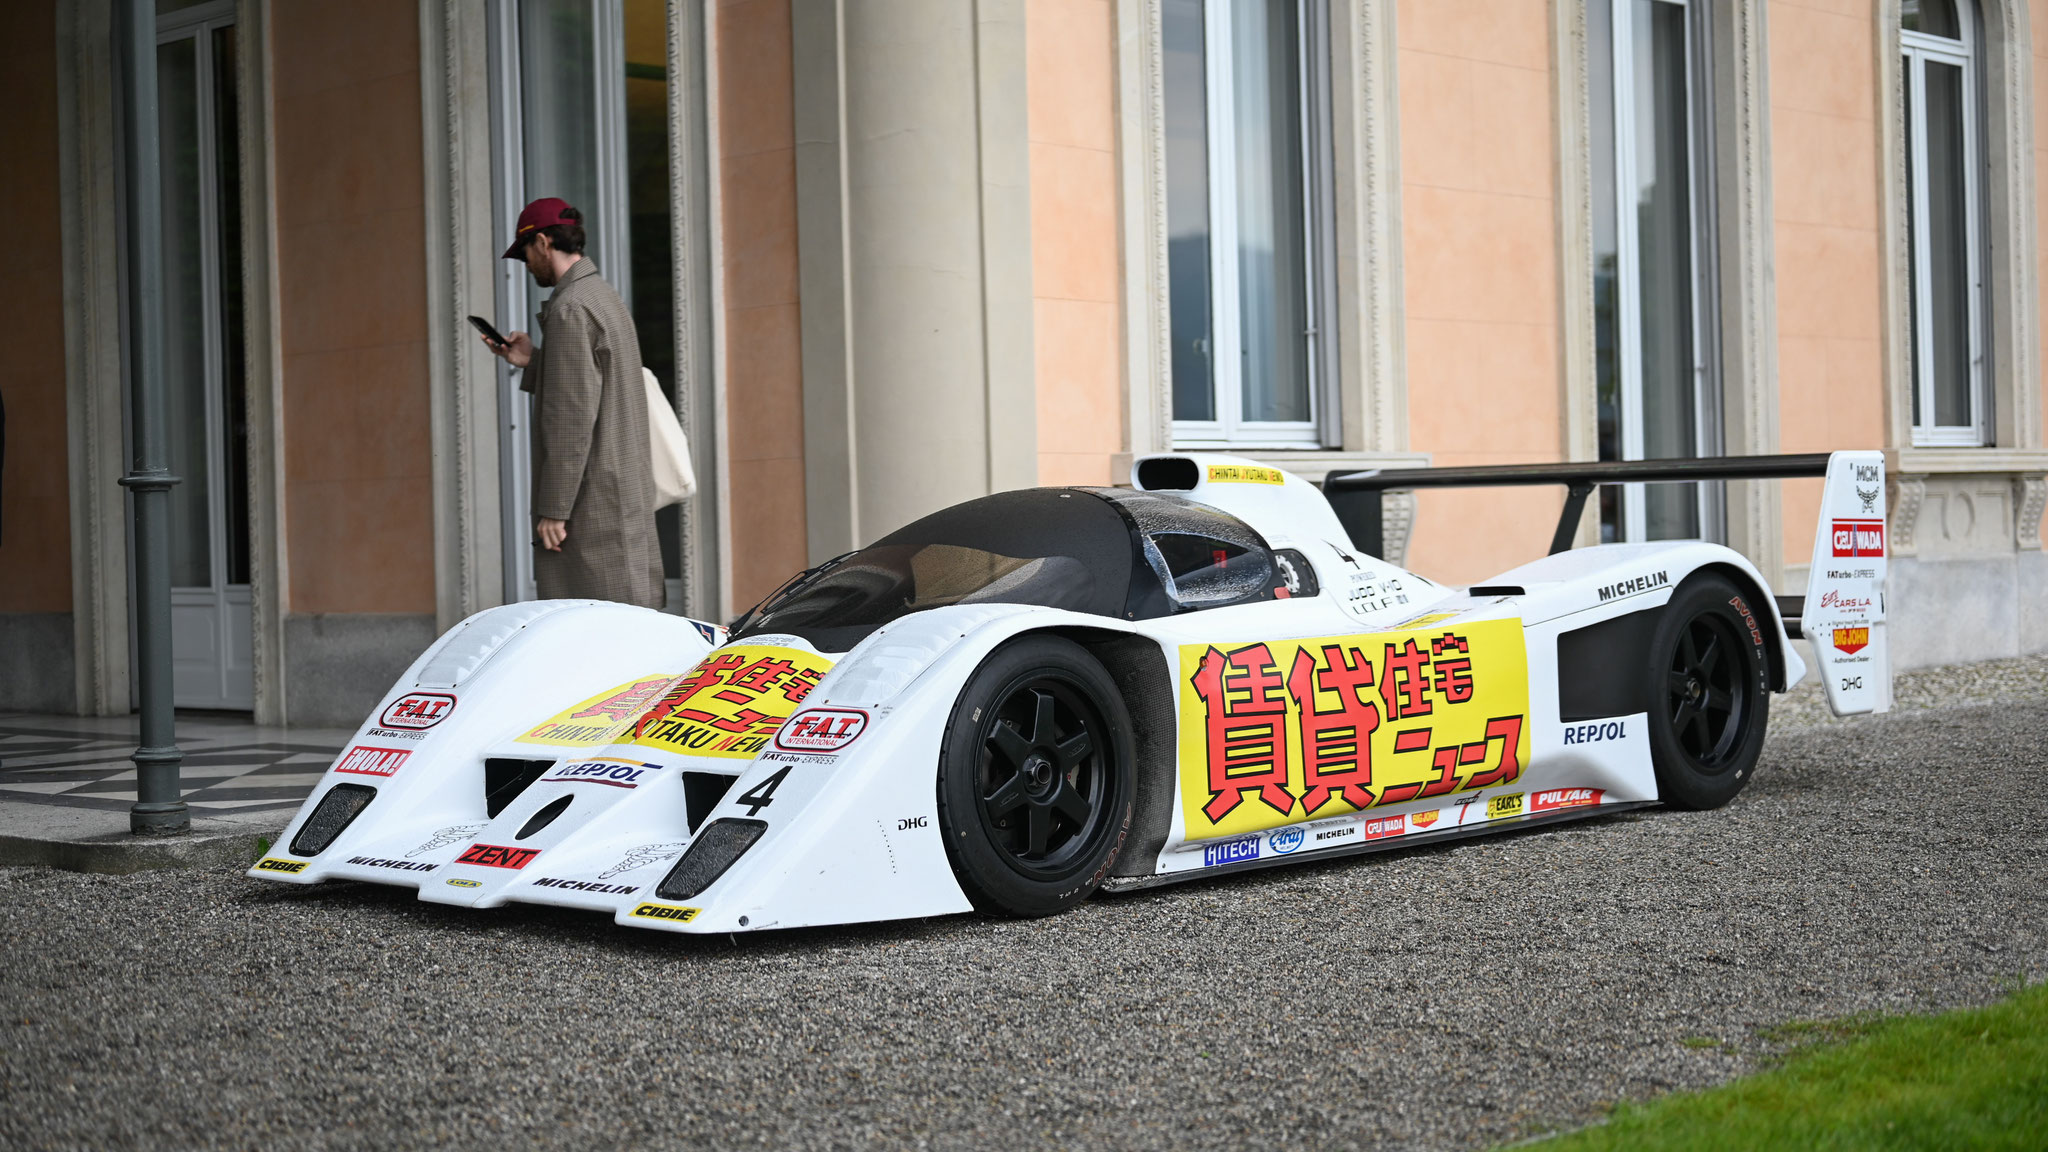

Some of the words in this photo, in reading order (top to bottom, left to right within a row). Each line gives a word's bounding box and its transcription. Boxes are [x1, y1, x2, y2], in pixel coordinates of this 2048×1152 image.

[1210, 468, 1240, 480] CHINTAI
[1856, 465, 1879, 482] MCM
[1856, 530, 1882, 550] WADA
[1597, 570, 1668, 601] MICHELIN
[1834, 599, 1857, 608] CARS
[1728, 595, 1763, 645] AVON
[1834, 630, 1847, 646] BIG
[1848, 628, 1869, 646] JOHN
[388, 717, 429, 726] INTERNATIONAL
[1563, 721, 1627, 745] REPSOL
[784, 738, 838, 747] INTERNATIONAL
[555, 762, 646, 783] REPSOL
[735, 766, 794, 817] 4
[1538, 789, 1594, 806] PULSAR
[1496, 794, 1524, 811] EARL'S
[897, 816, 928, 831] DHG
[1316, 827, 1355, 841] MICHELIN
[459, 845, 538, 867] ZENT
[1207, 838, 1258, 866] HITECH
[346, 856, 441, 872] MICHELIN
[532, 877, 641, 895] MICHELIN
